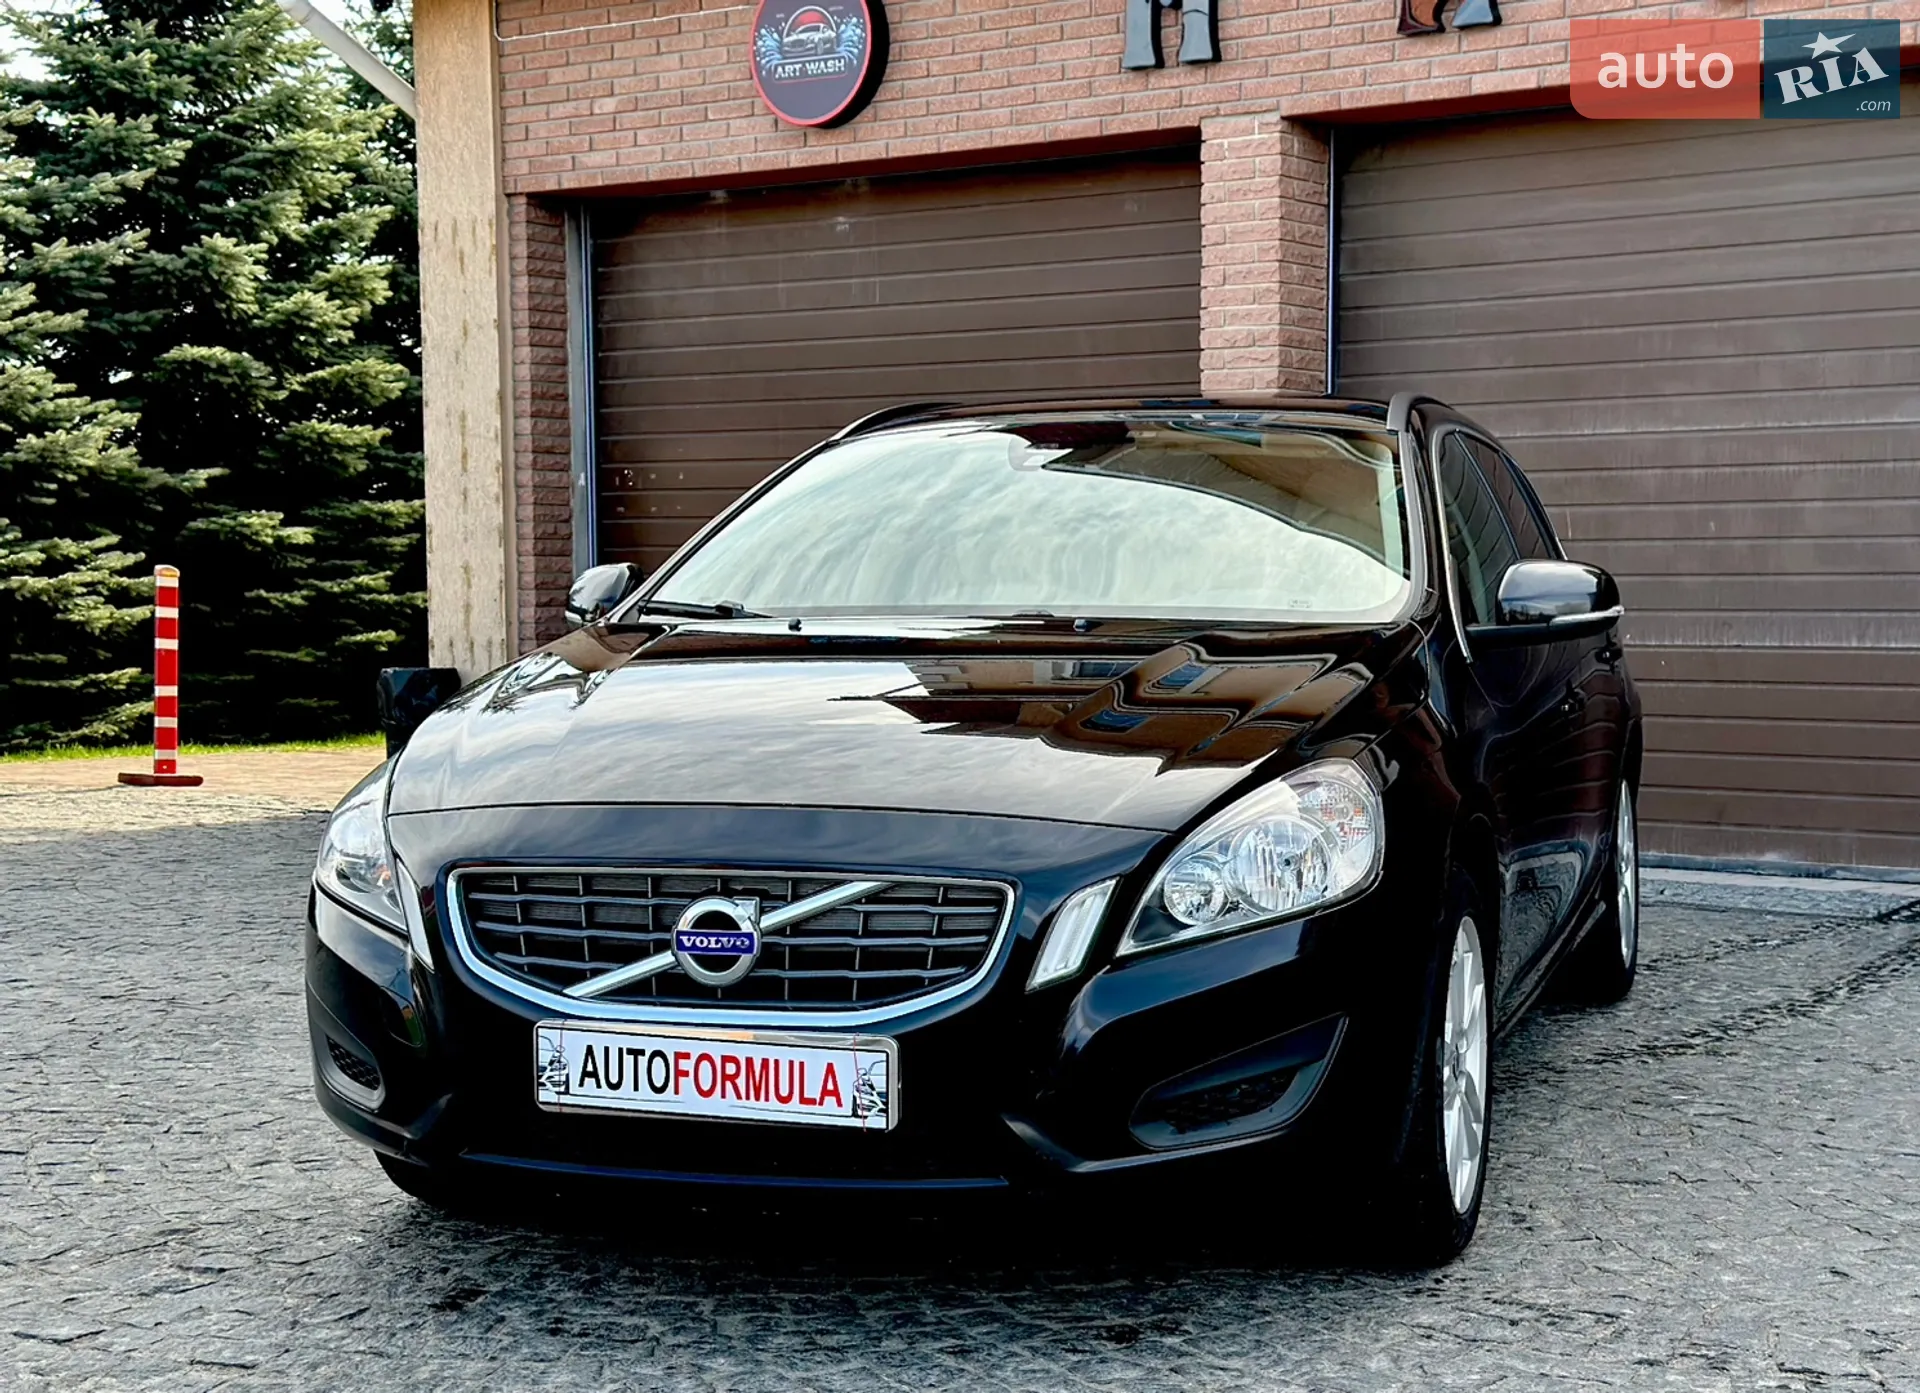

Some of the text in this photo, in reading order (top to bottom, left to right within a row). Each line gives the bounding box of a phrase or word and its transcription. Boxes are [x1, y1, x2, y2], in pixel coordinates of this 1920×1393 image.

[775, 59, 845, 78] ART WASH
[679, 935, 750, 949] VOLVO
[578, 1044, 843, 1108] AUTOFORMULA
